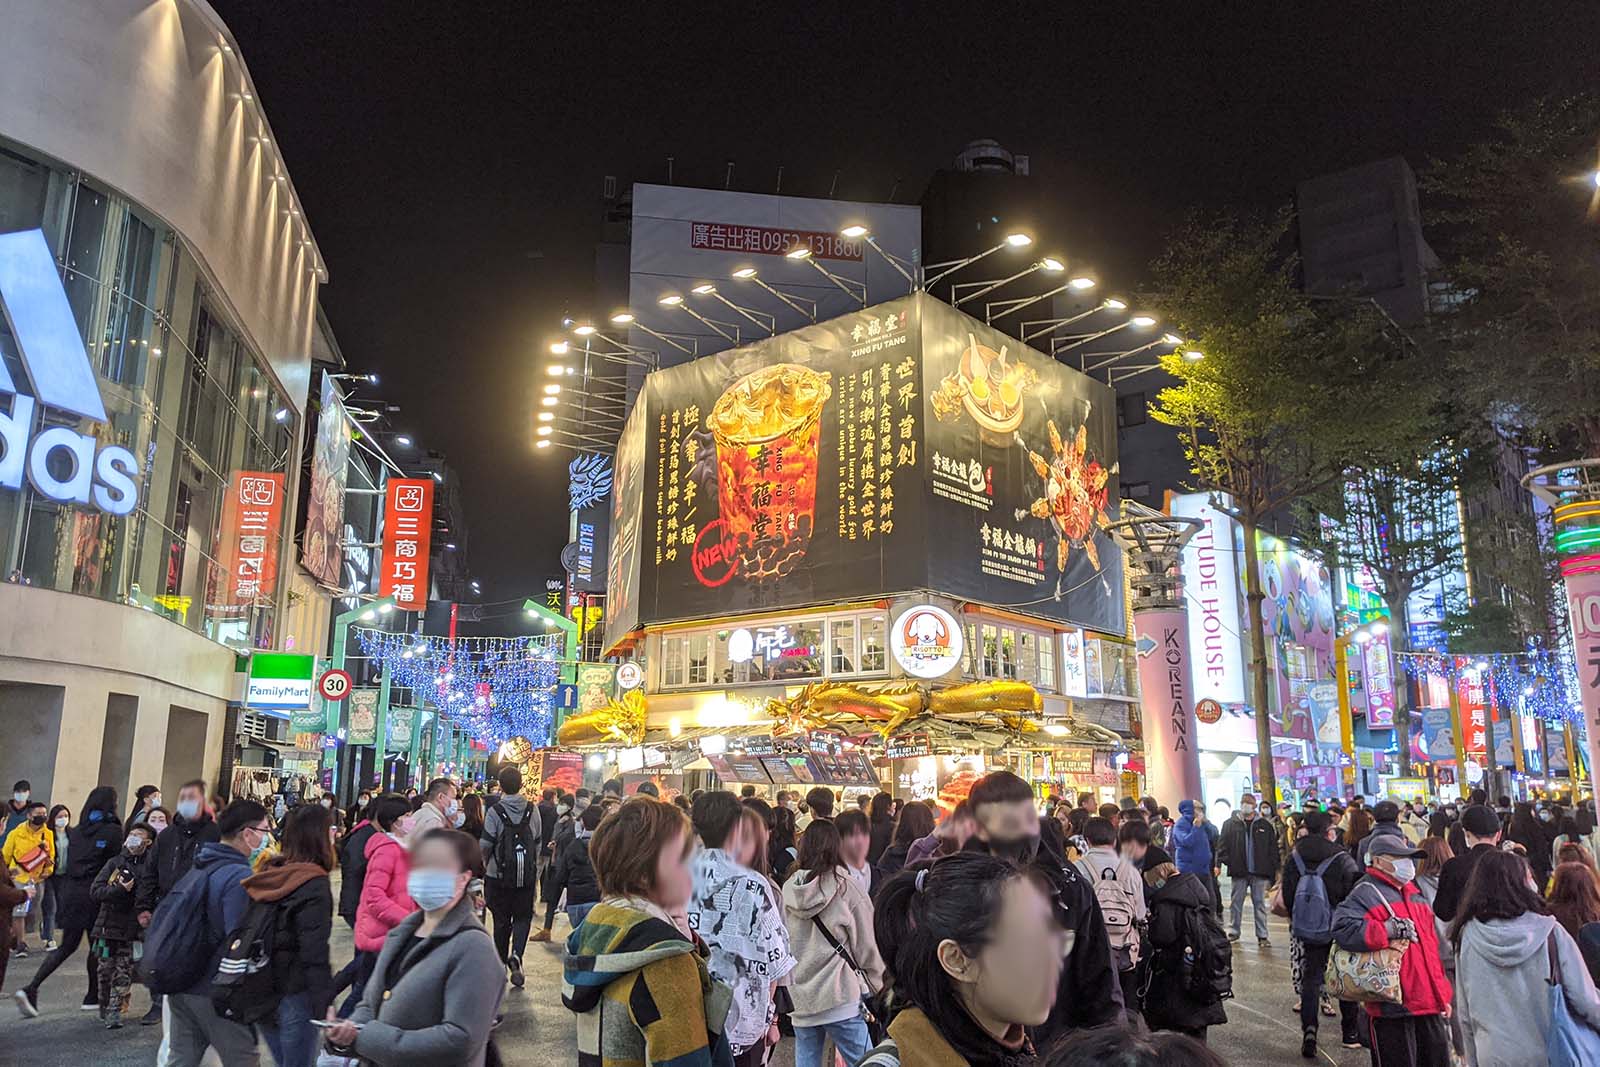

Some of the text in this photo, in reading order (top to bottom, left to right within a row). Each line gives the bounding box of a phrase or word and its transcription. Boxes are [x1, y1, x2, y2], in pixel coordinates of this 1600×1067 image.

[851, 314, 898, 342] 幸福堂
[851, 346, 872, 358] XING
[872, 342, 883, 352] FU
[884, 336, 906, 348] TANG
[896, 356, 918, 468] 世界首創
[837, 430, 846, 461] unique
[848, 423, 856, 453] global
[848, 457, 856, 490] luxury
[751, 444, 774, 547] 幸福堂
[776, 484, 782, 497] FU
[848, 495, 856, 515] gold
[580, 523, 594, 554] BLUE
[848, 521, 856, 540] foil
[392, 517, 418, 602] 三商巧福
[698, 536, 739, 570] NEW
[578, 556, 592, 582] WAY
[1202, 598, 1224, 677] HOUSE
[249, 685, 309, 698] FamilyMart
[326, 679, 344, 692] 30
[1164, 628, 1188, 752] KOREANA
